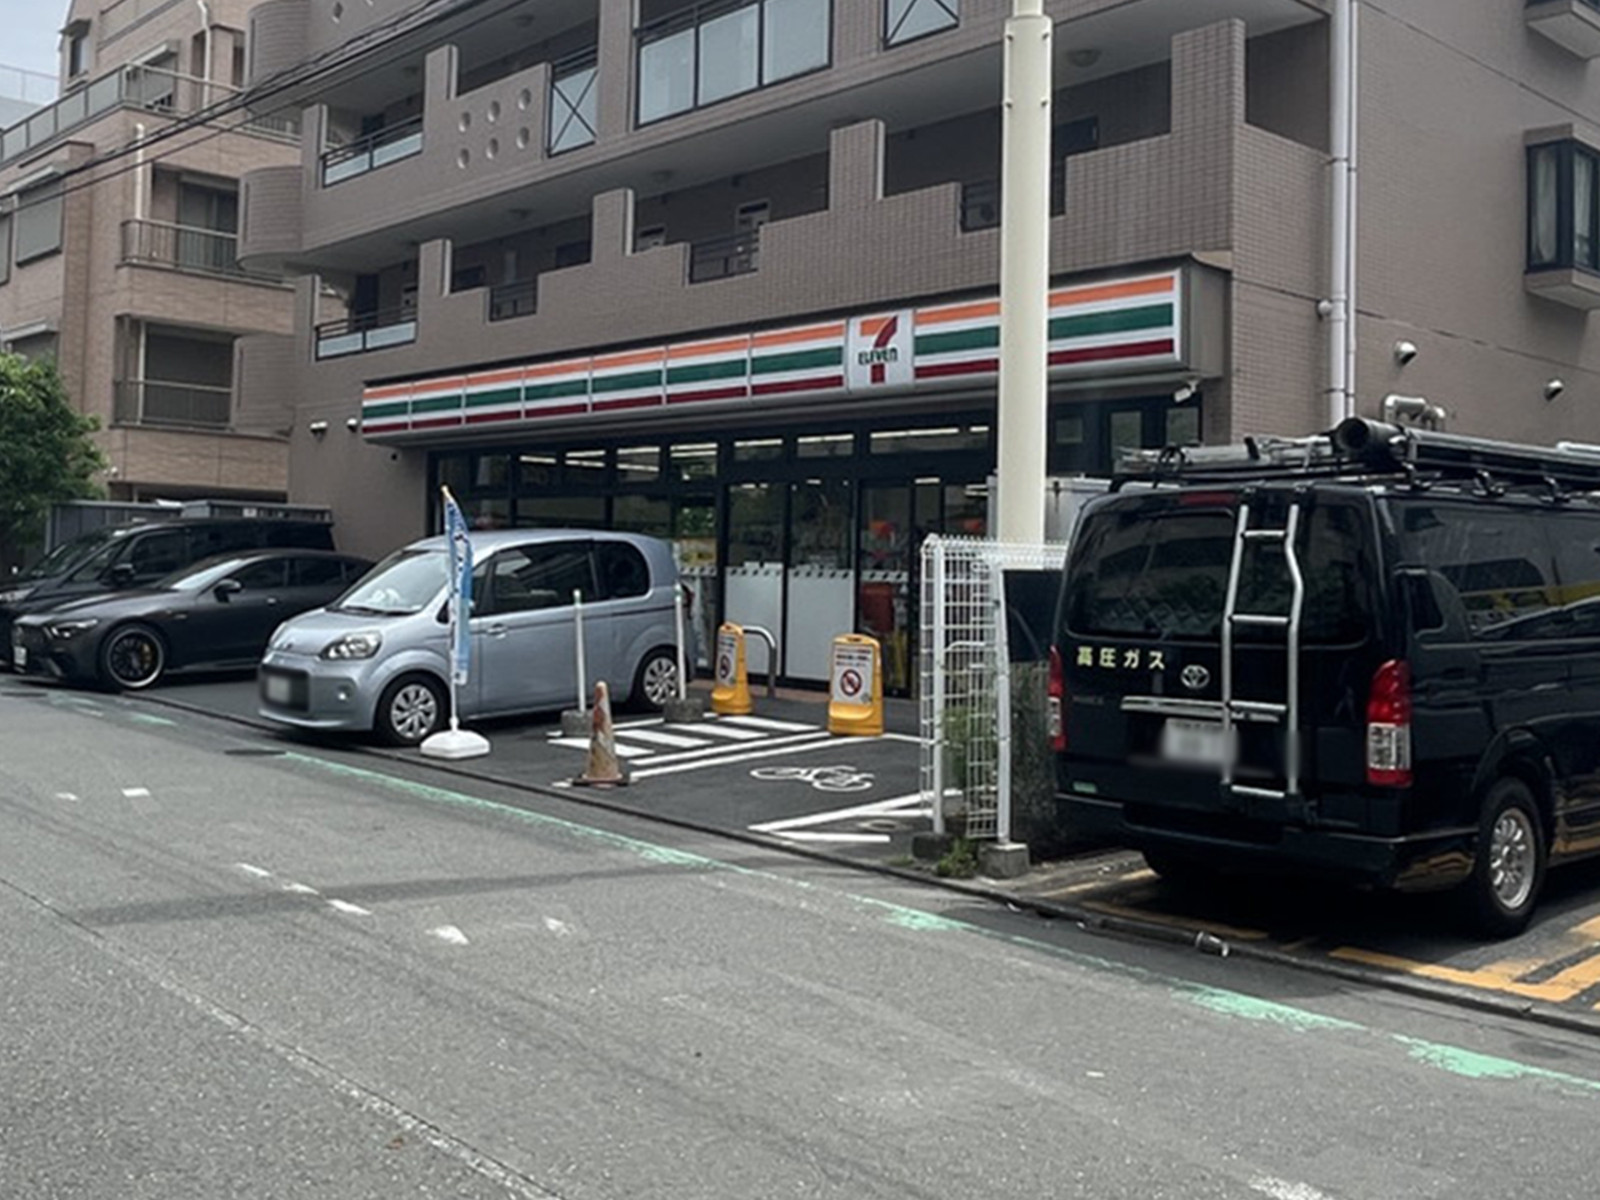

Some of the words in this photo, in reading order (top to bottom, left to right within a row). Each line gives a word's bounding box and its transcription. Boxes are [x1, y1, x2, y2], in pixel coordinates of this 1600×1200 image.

[860, 316, 898, 384] 7
[1076, 645, 1166, 670] 高圧ガス
